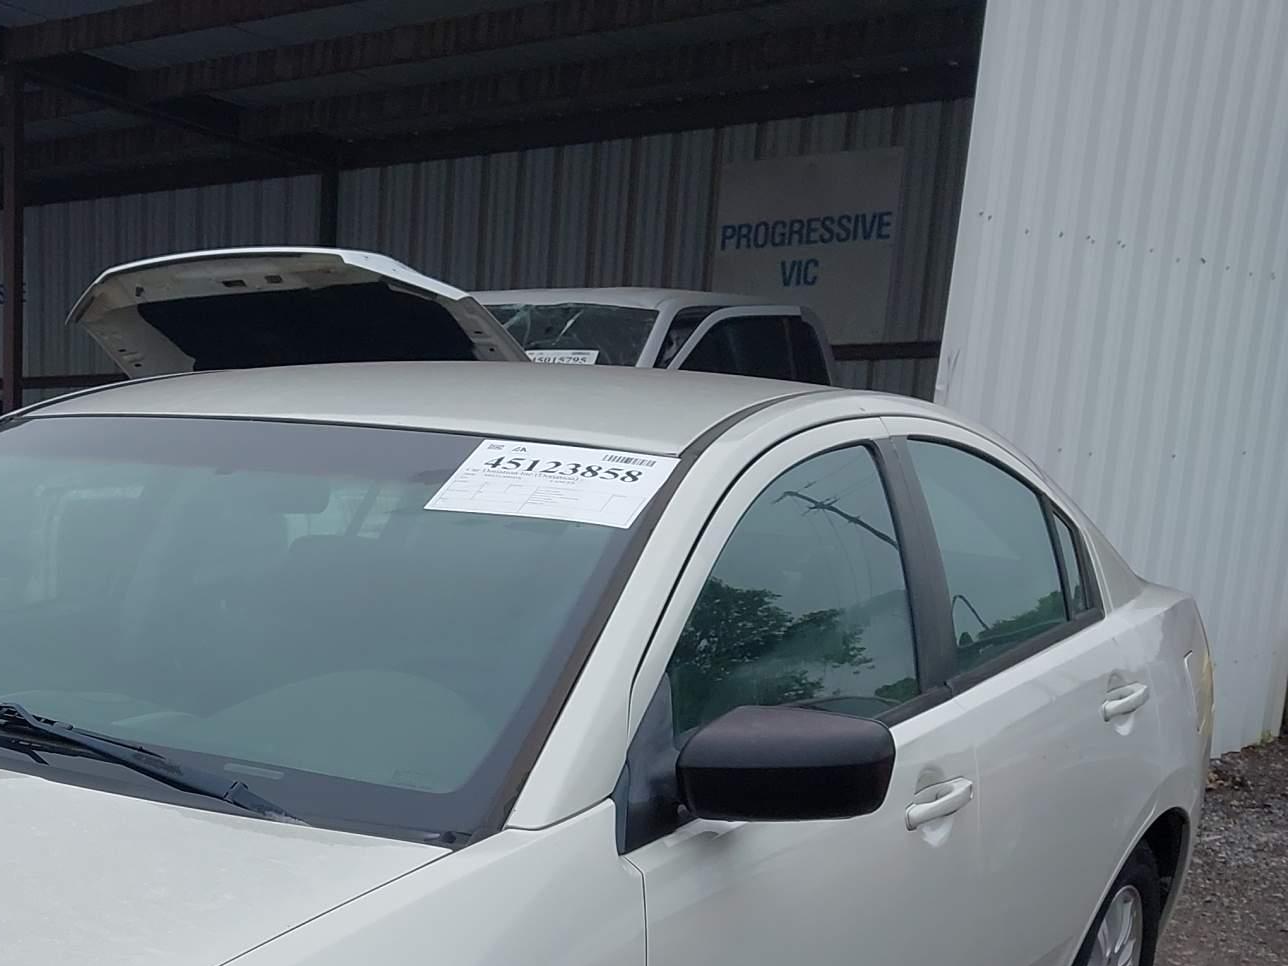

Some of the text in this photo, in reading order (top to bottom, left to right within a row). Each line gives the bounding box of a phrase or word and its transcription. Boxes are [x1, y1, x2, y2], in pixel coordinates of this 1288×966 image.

[720, 211, 893, 250] PROGRESSIVE
[780, 258, 820, 287] VIC
[484, 456, 643, 483] 45123858
